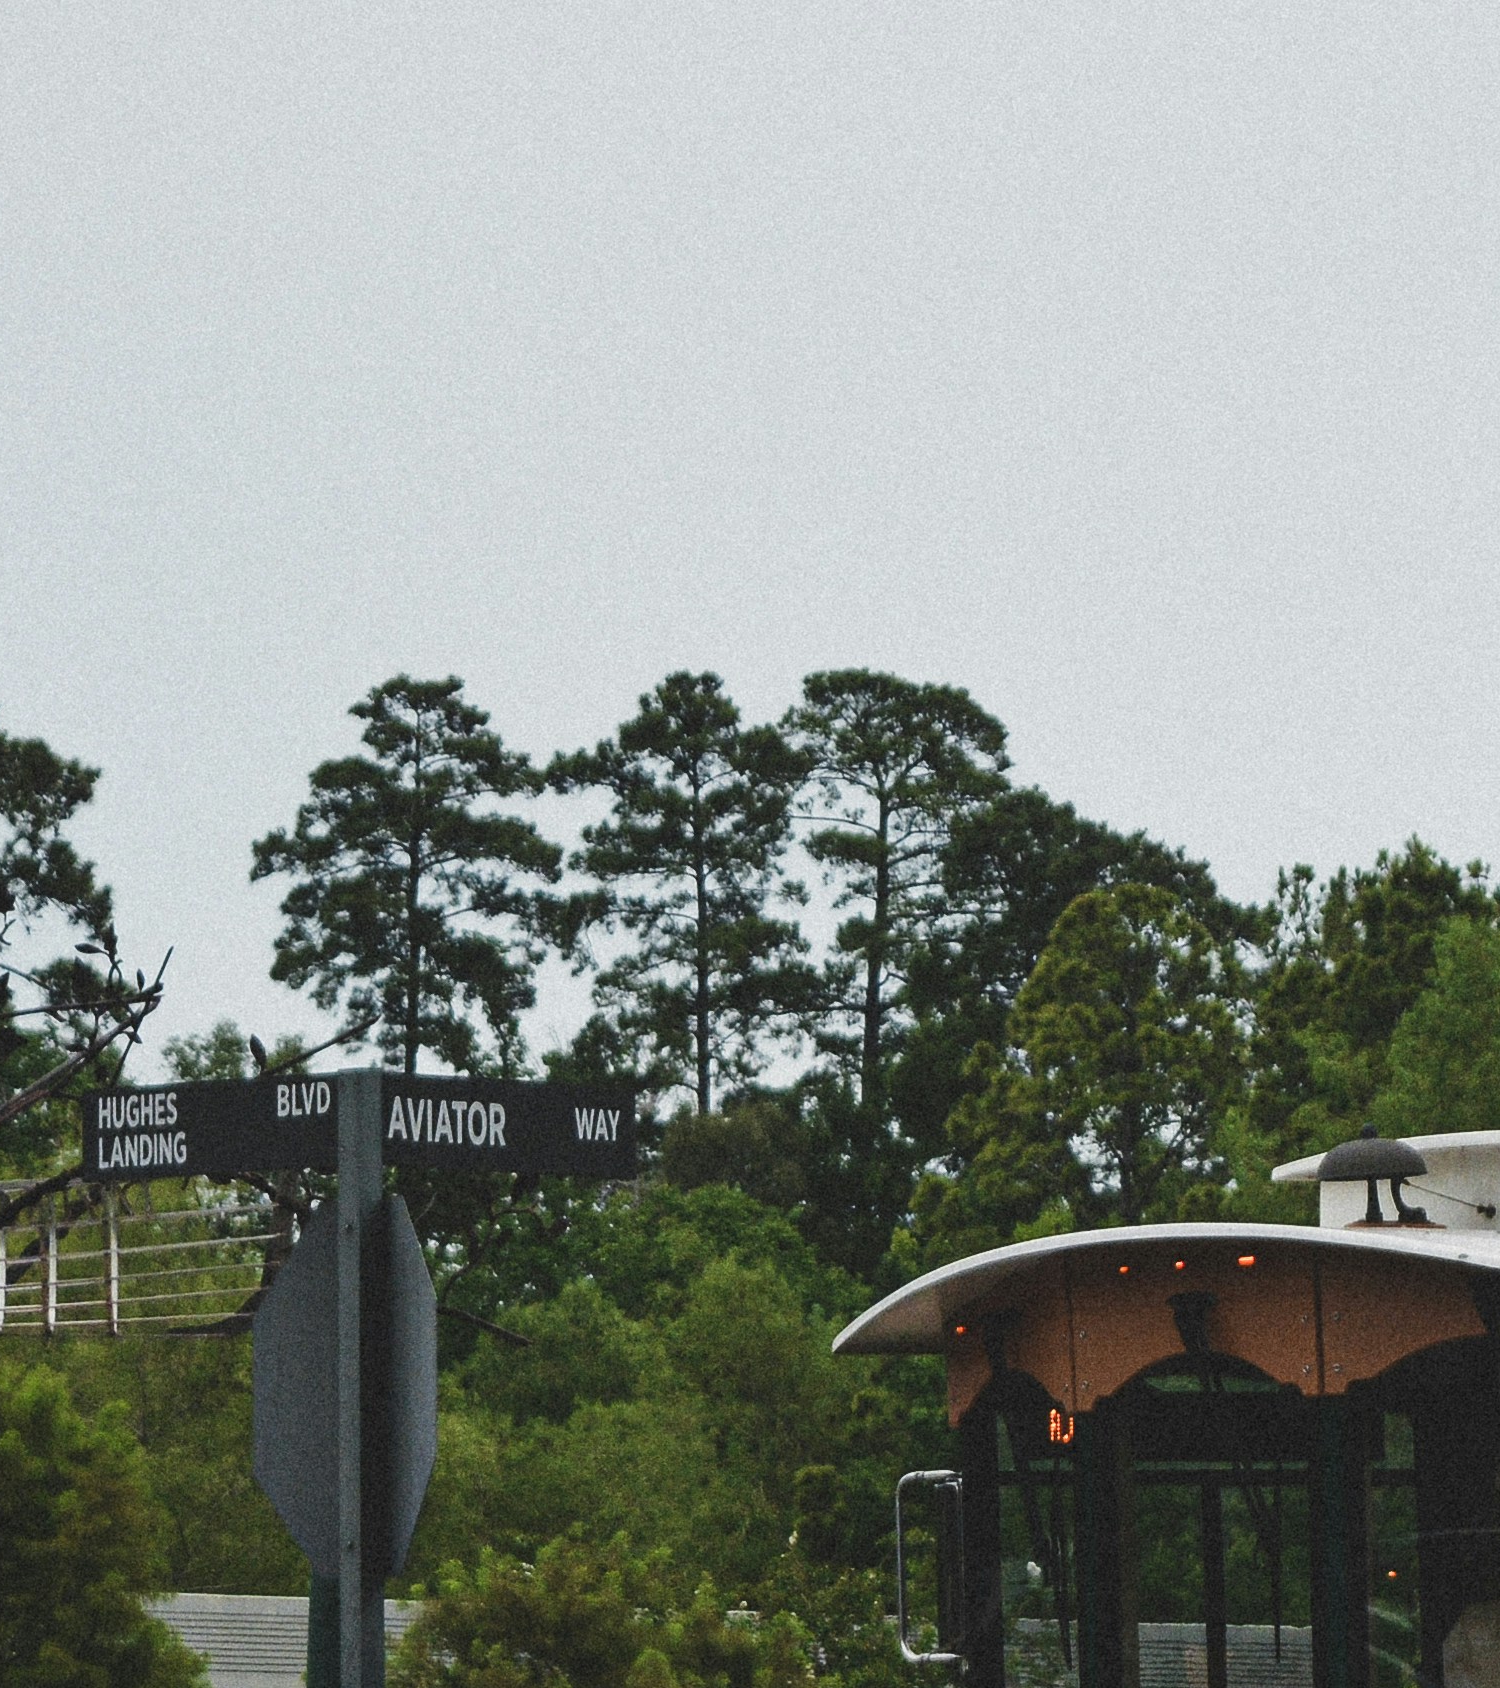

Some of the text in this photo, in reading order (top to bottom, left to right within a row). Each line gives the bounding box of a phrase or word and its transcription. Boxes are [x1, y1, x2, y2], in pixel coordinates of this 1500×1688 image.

[97, 1092, 178, 1129] HUGHES
[277, 1081, 331, 1118] BLVD
[387, 1095, 621, 1147] AVIATOR WAY
[98, 1131, 187, 1169] LANDING
